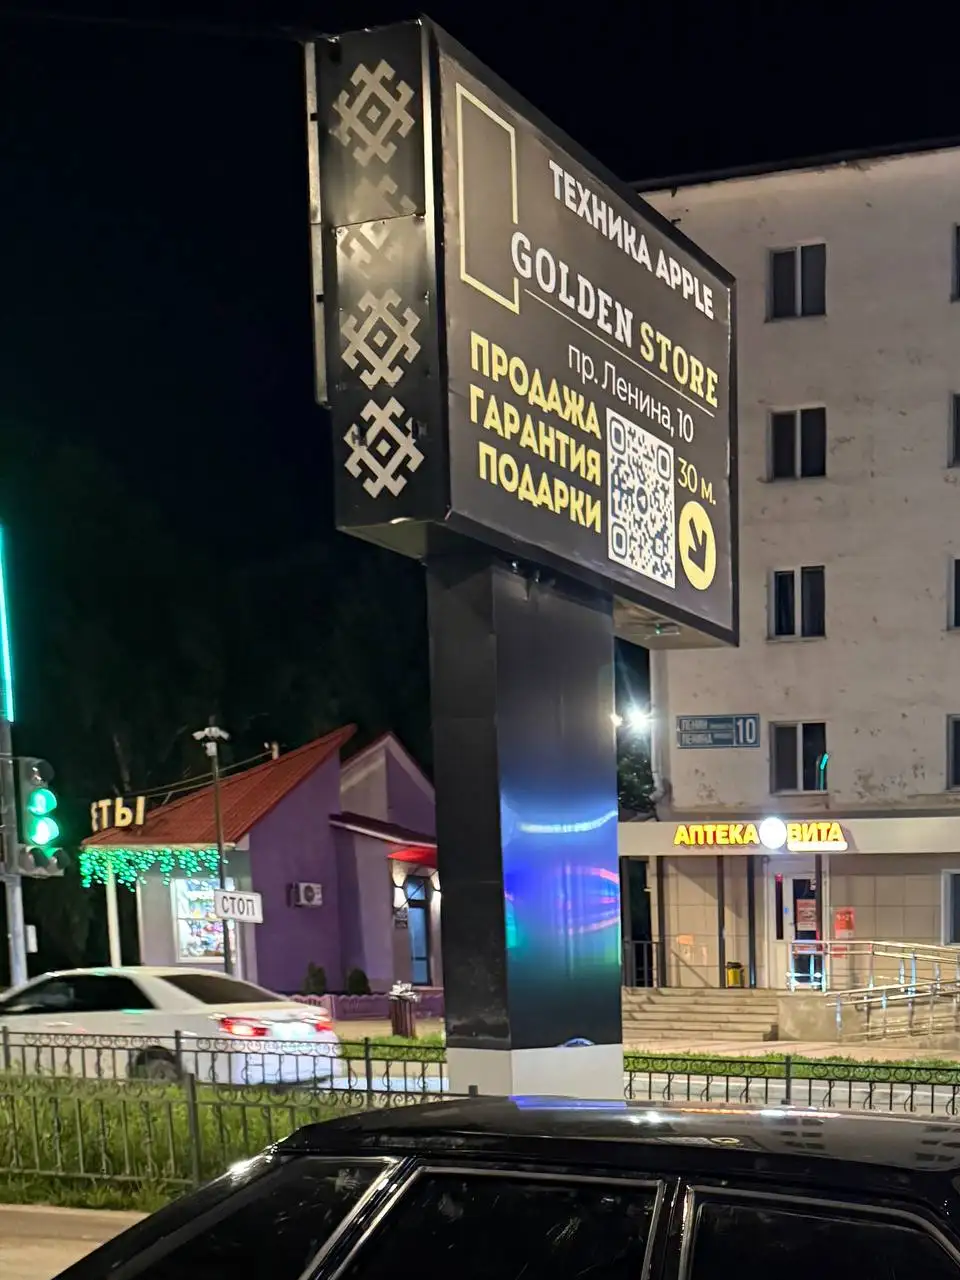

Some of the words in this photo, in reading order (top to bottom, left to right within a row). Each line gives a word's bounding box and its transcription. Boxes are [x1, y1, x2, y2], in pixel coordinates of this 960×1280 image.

[548, 159, 653, 272] ТЕХНИКА
[655, 249, 714, 320] APPLE
[511, 231, 634, 348] GOLDEN
[640, 322, 718, 408] STORE
[470, 331, 602, 440] ПРОДАЖА
[568, 344, 598, 385] пр.
[601, 361, 674, 438] Ленина,
[677, 408, 694, 443] 10
[470, 384, 601, 487] ГАРАНТИЯ
[678, 457, 698, 493] 30
[478, 441, 601, 533] ПОДАРКИ
[737, 718, 756, 744] 10
[673, 823, 761, 846] АПТЕКА
[786, 822, 847, 843] ВИТА
[221, 896, 255, 916] СТОП
